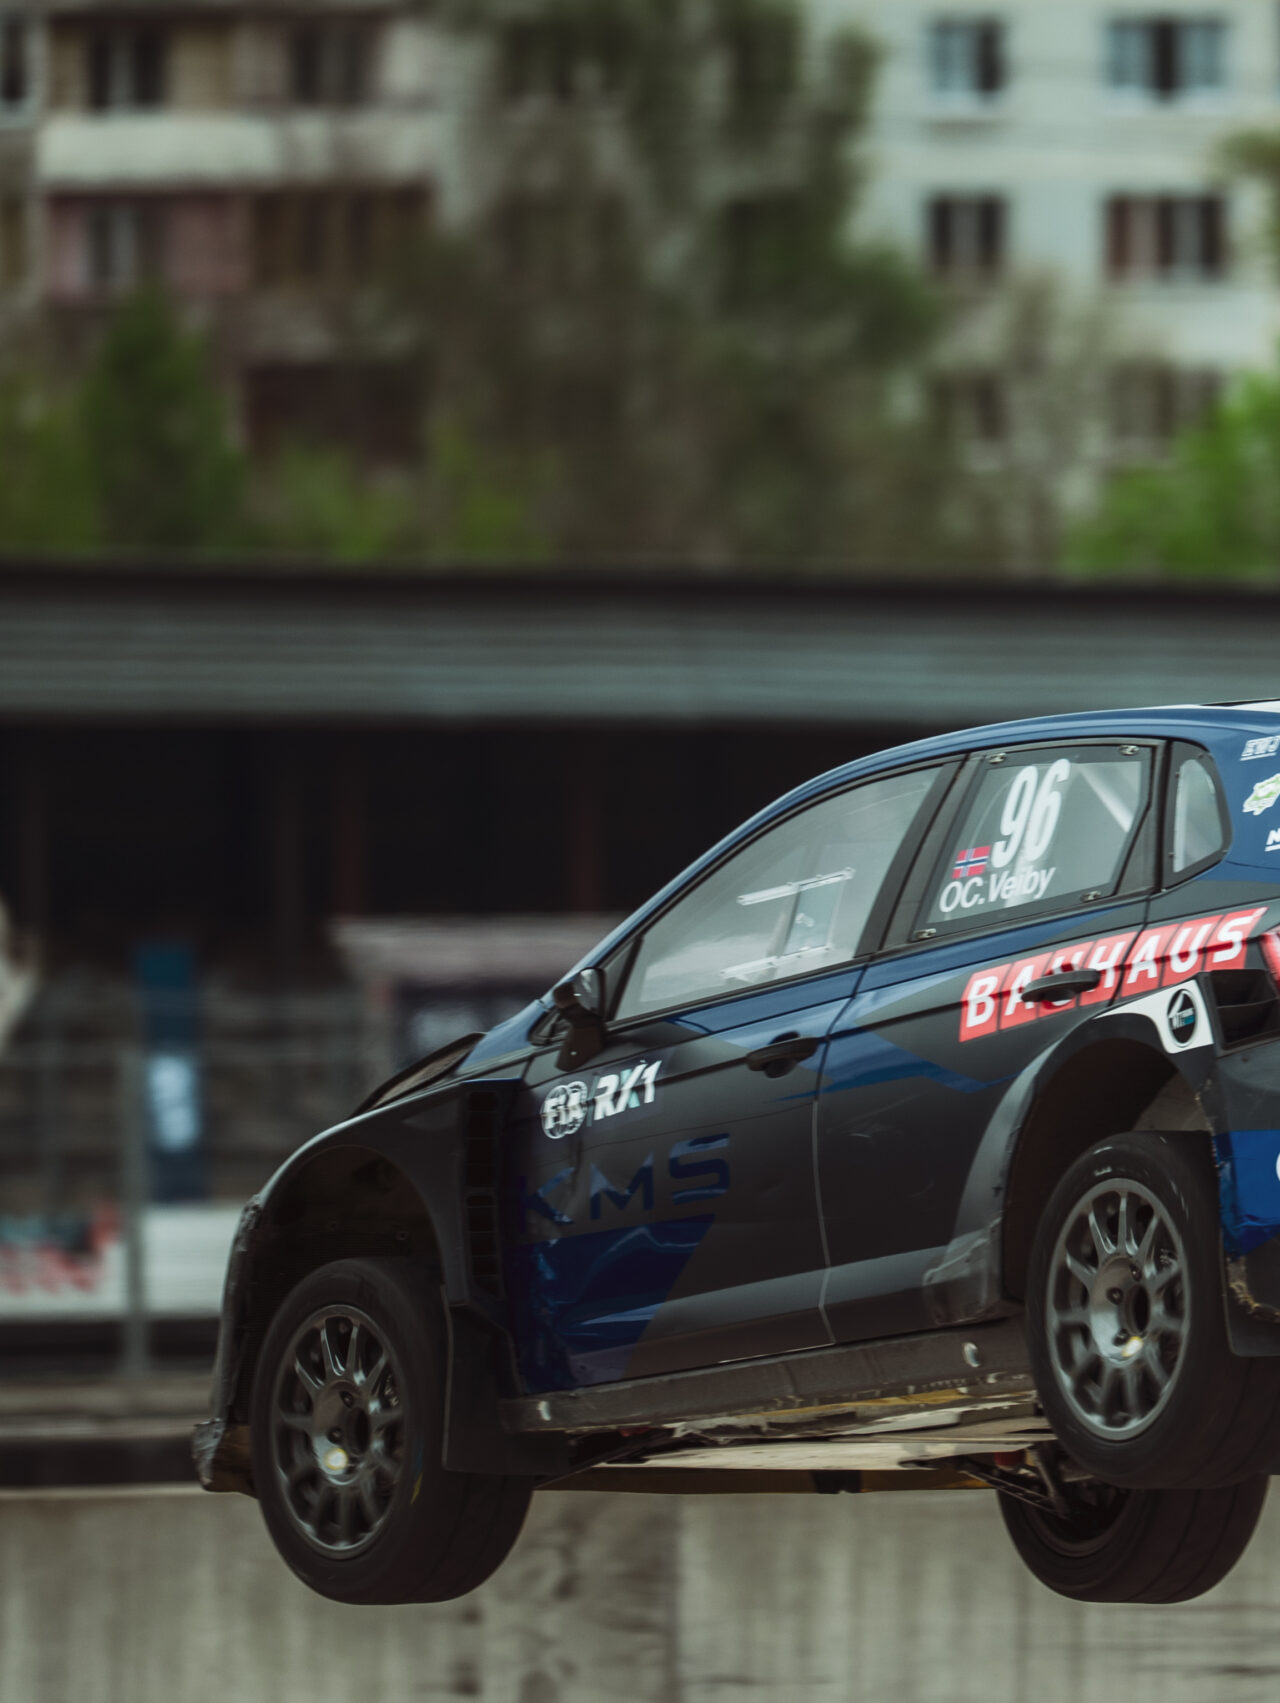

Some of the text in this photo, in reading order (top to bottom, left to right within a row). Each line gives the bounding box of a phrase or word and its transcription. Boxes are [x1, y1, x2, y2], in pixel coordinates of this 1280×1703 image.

[990, 758, 1072, 869] 96
[593, 1060, 663, 1121] RX1
[518, 1132, 732, 1233] KMS
